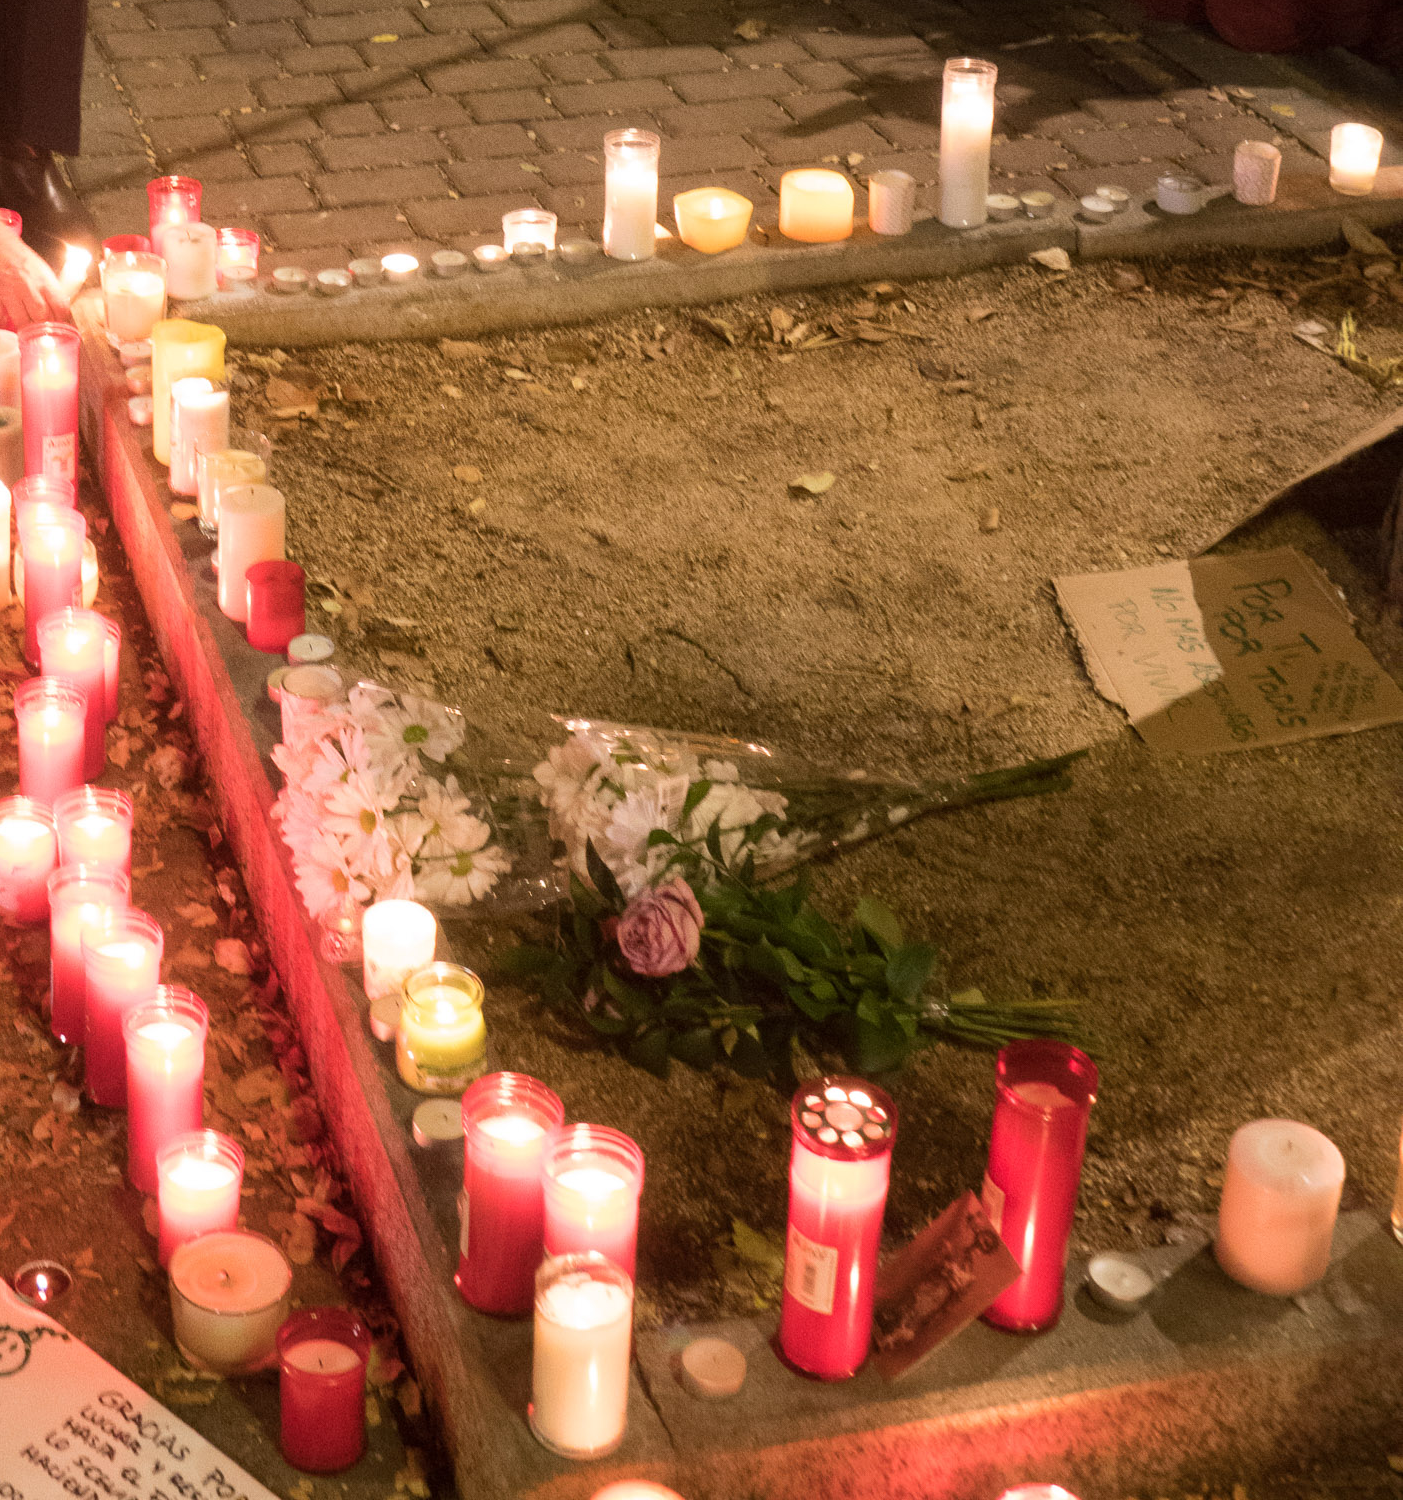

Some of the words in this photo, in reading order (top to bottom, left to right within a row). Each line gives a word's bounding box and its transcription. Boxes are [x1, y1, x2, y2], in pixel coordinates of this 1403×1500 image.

[1106, 597, 1147, 642] POR
[1150, 586, 1186, 613] NO
[1233, 577, 1294, 627] POR
[1217, 605, 1264, 657] POR
[45, 1429, 70, 1452] LO
[62, 1415, 116, 1462] HASTA
[79, 1405, 143, 1456] LUCHAR
[98, 1389, 191, 1463] GRACIAS
[201, 1466, 248, 1500] PO
